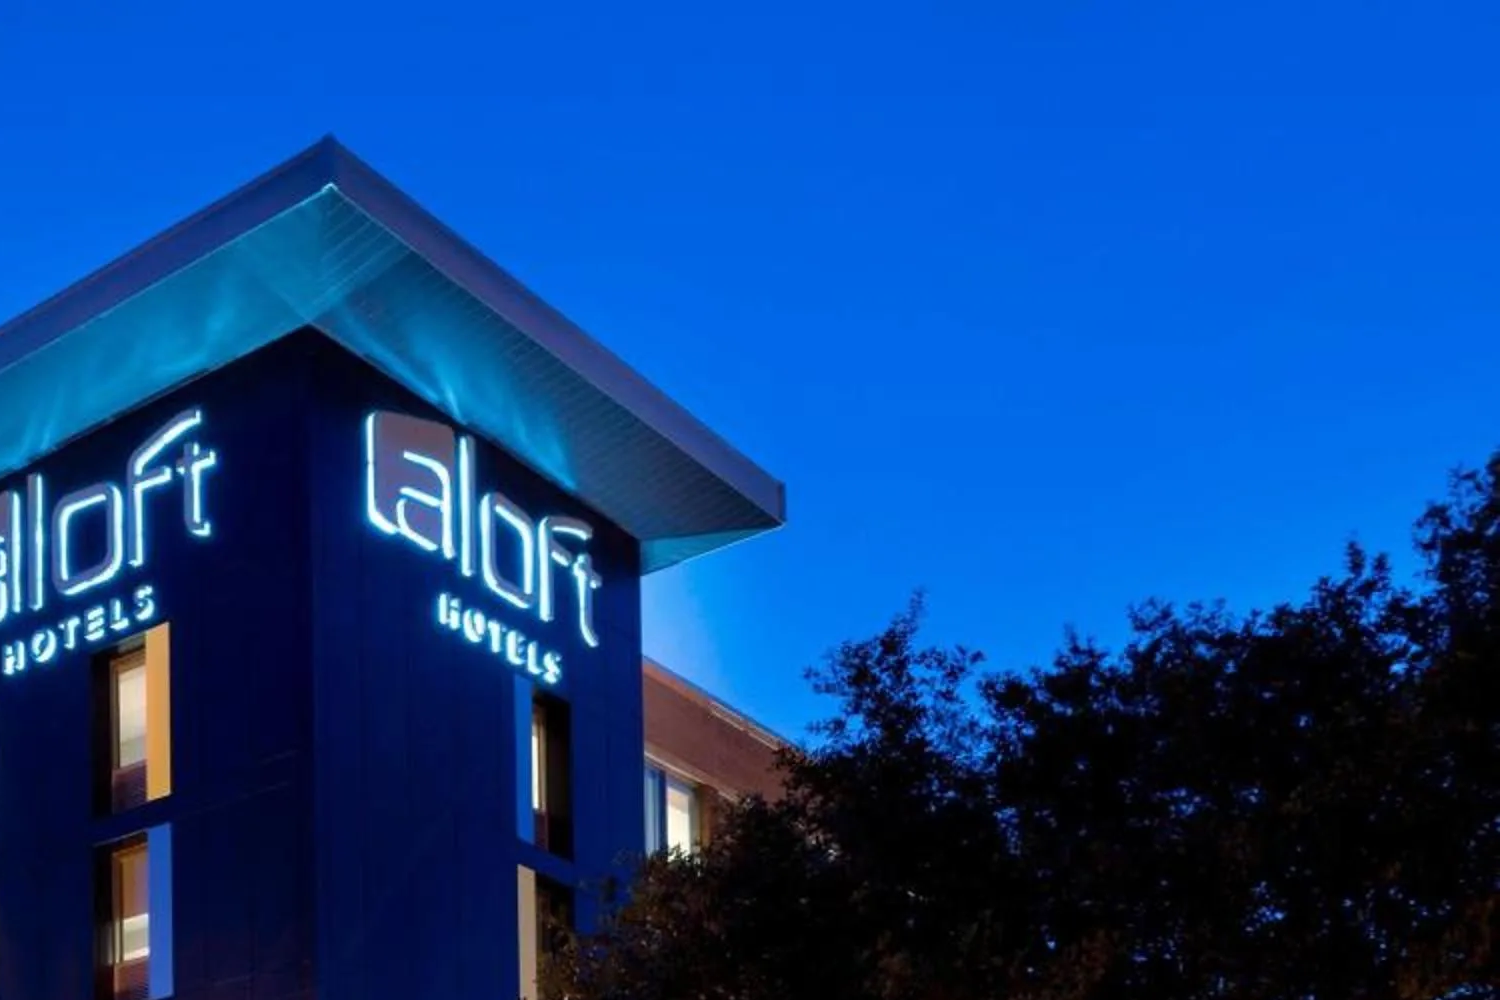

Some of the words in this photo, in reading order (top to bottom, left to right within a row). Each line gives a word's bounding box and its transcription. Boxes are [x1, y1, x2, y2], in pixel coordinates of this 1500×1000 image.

[365, 410, 602, 648] aloft
[2, 584, 155, 676] HOTELS
[437, 592, 562, 685] HOTELS
